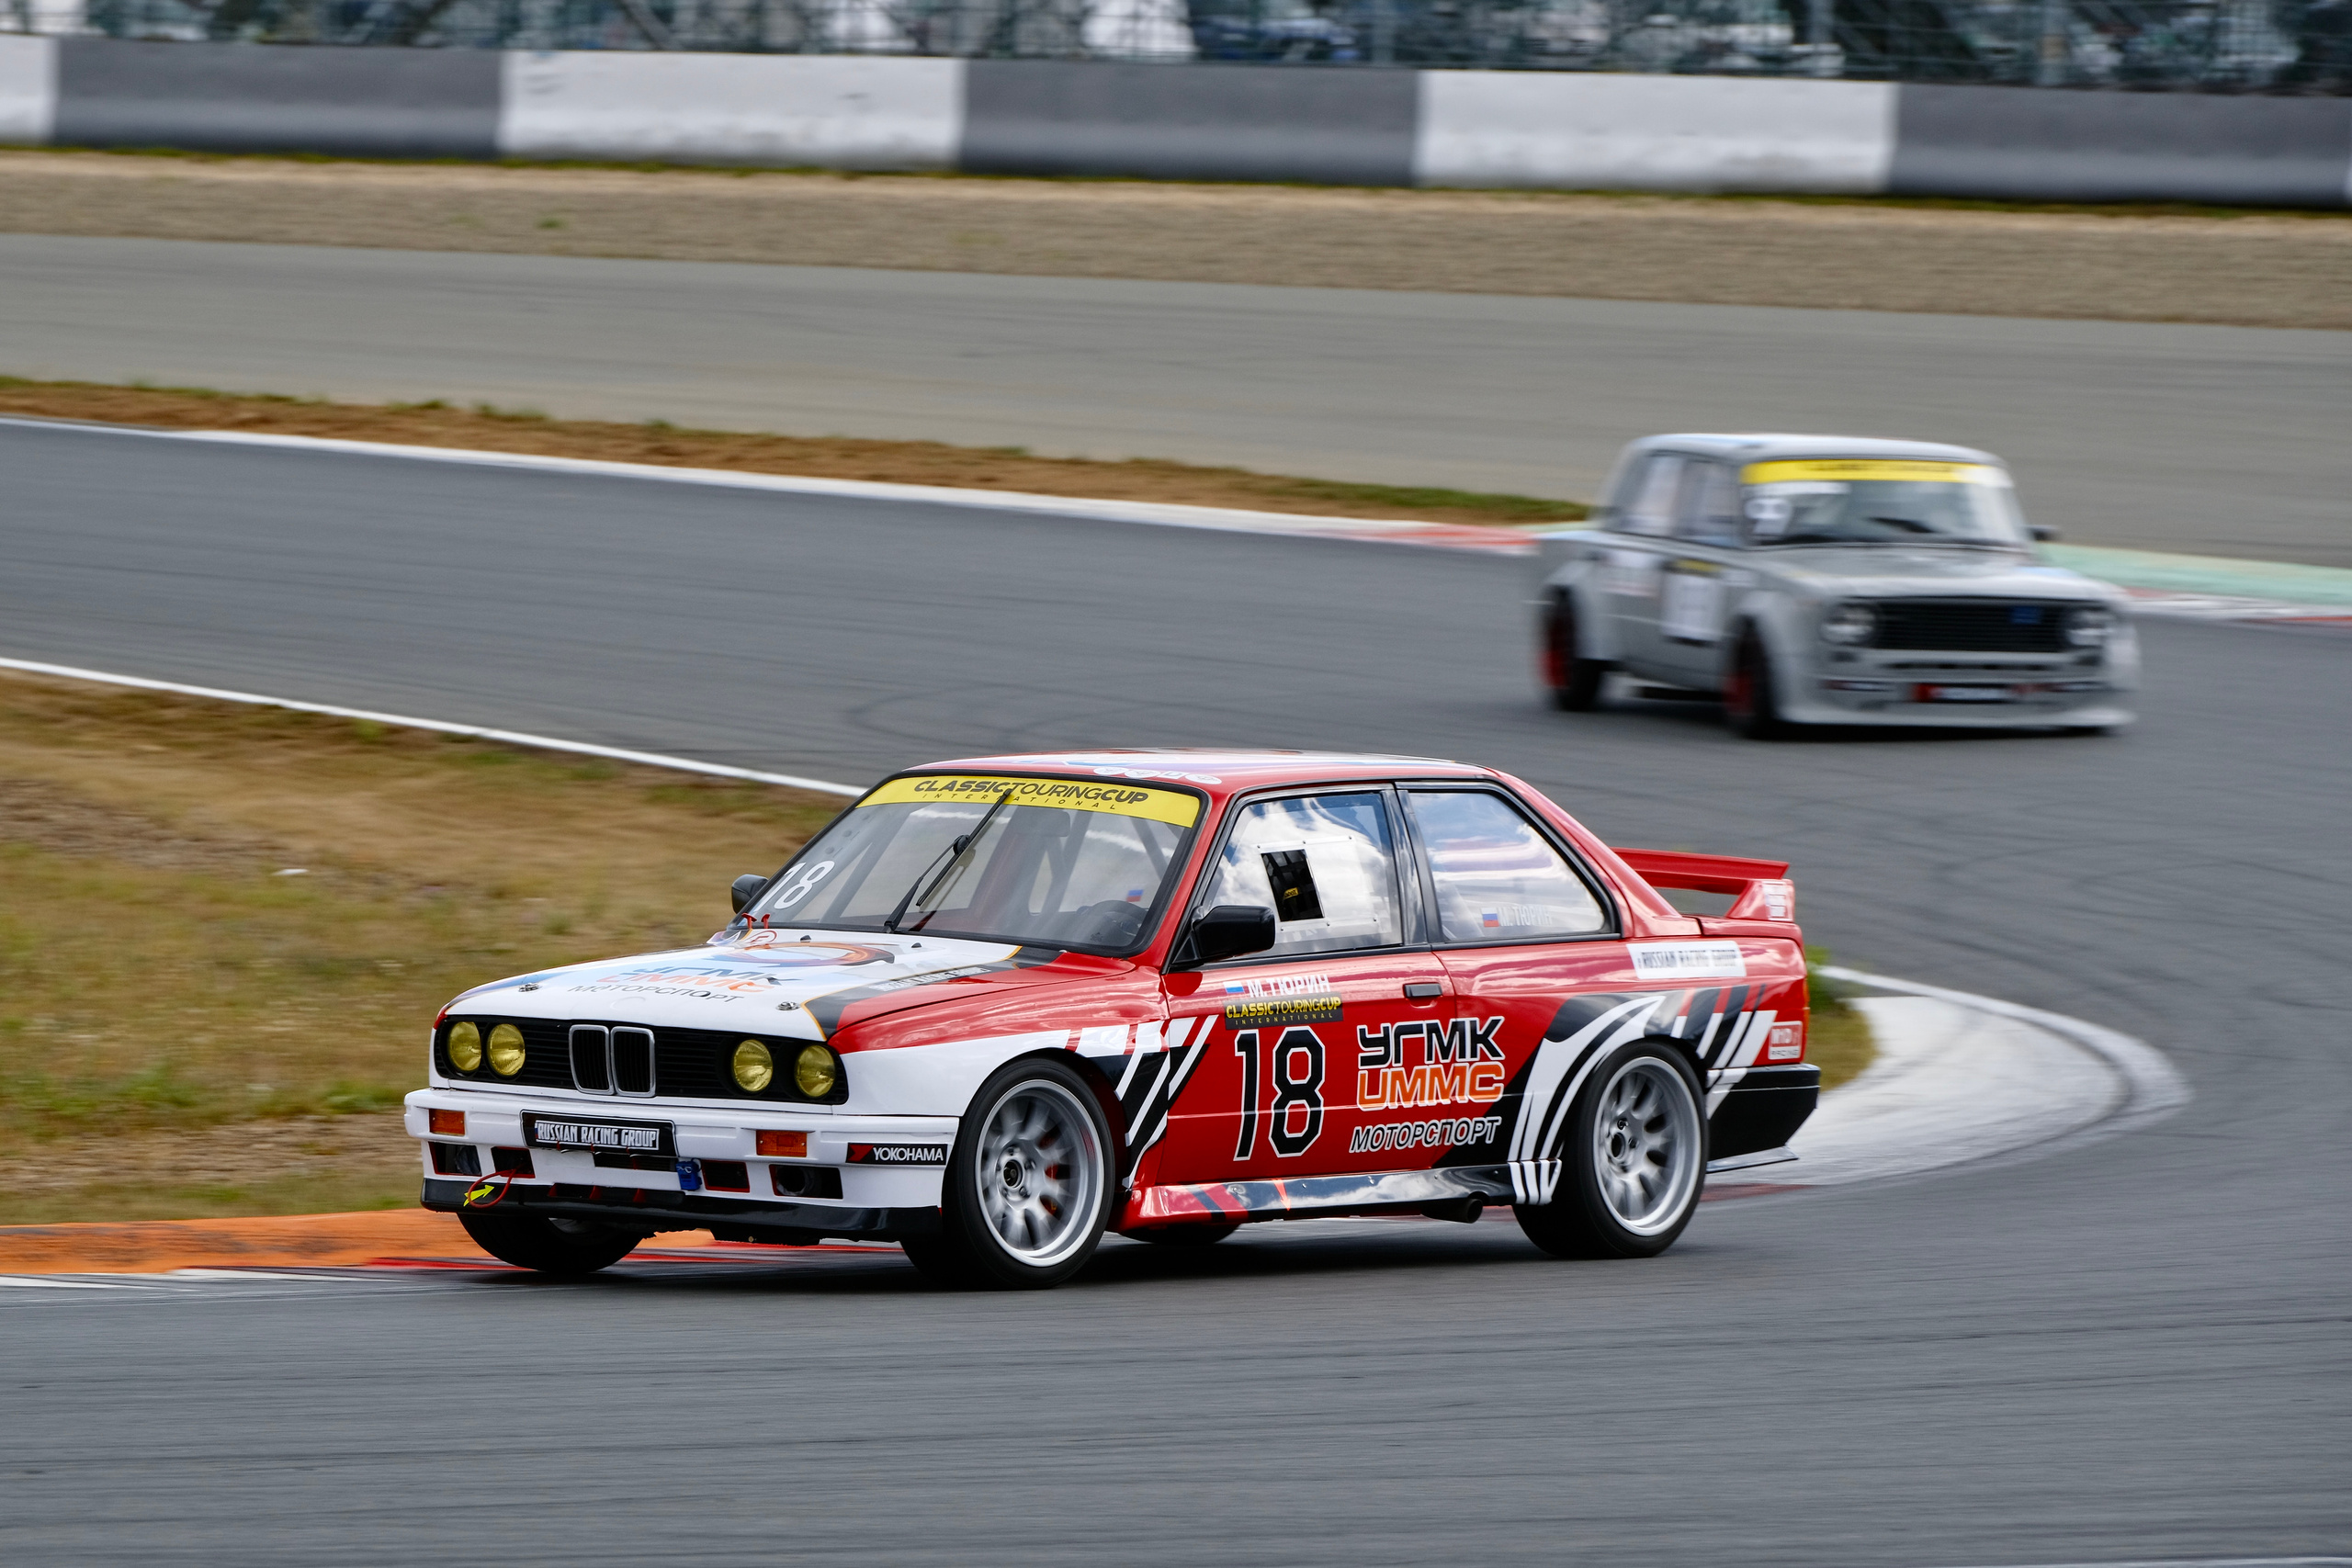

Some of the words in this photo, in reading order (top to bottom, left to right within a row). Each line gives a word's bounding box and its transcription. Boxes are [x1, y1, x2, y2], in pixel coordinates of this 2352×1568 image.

[753, 860, 835, 912] 18
[1235, 1012, 1333, 1025] INTERNATIONAL
[1357, 1016, 1505, 1069] УГМК
[1233, 1026, 1326, 1161] 18
[1356, 1063, 1505, 1111] UMMC
[537, 1122, 578, 1143] RUSSIAN
[581, 1126, 618, 1145] RACING
[621, 1129, 657, 1147] GROUP
[873, 1147, 944, 1161] YOKOHAMA
[1349, 1116, 1502, 1153] МОТОРСПОРТ
